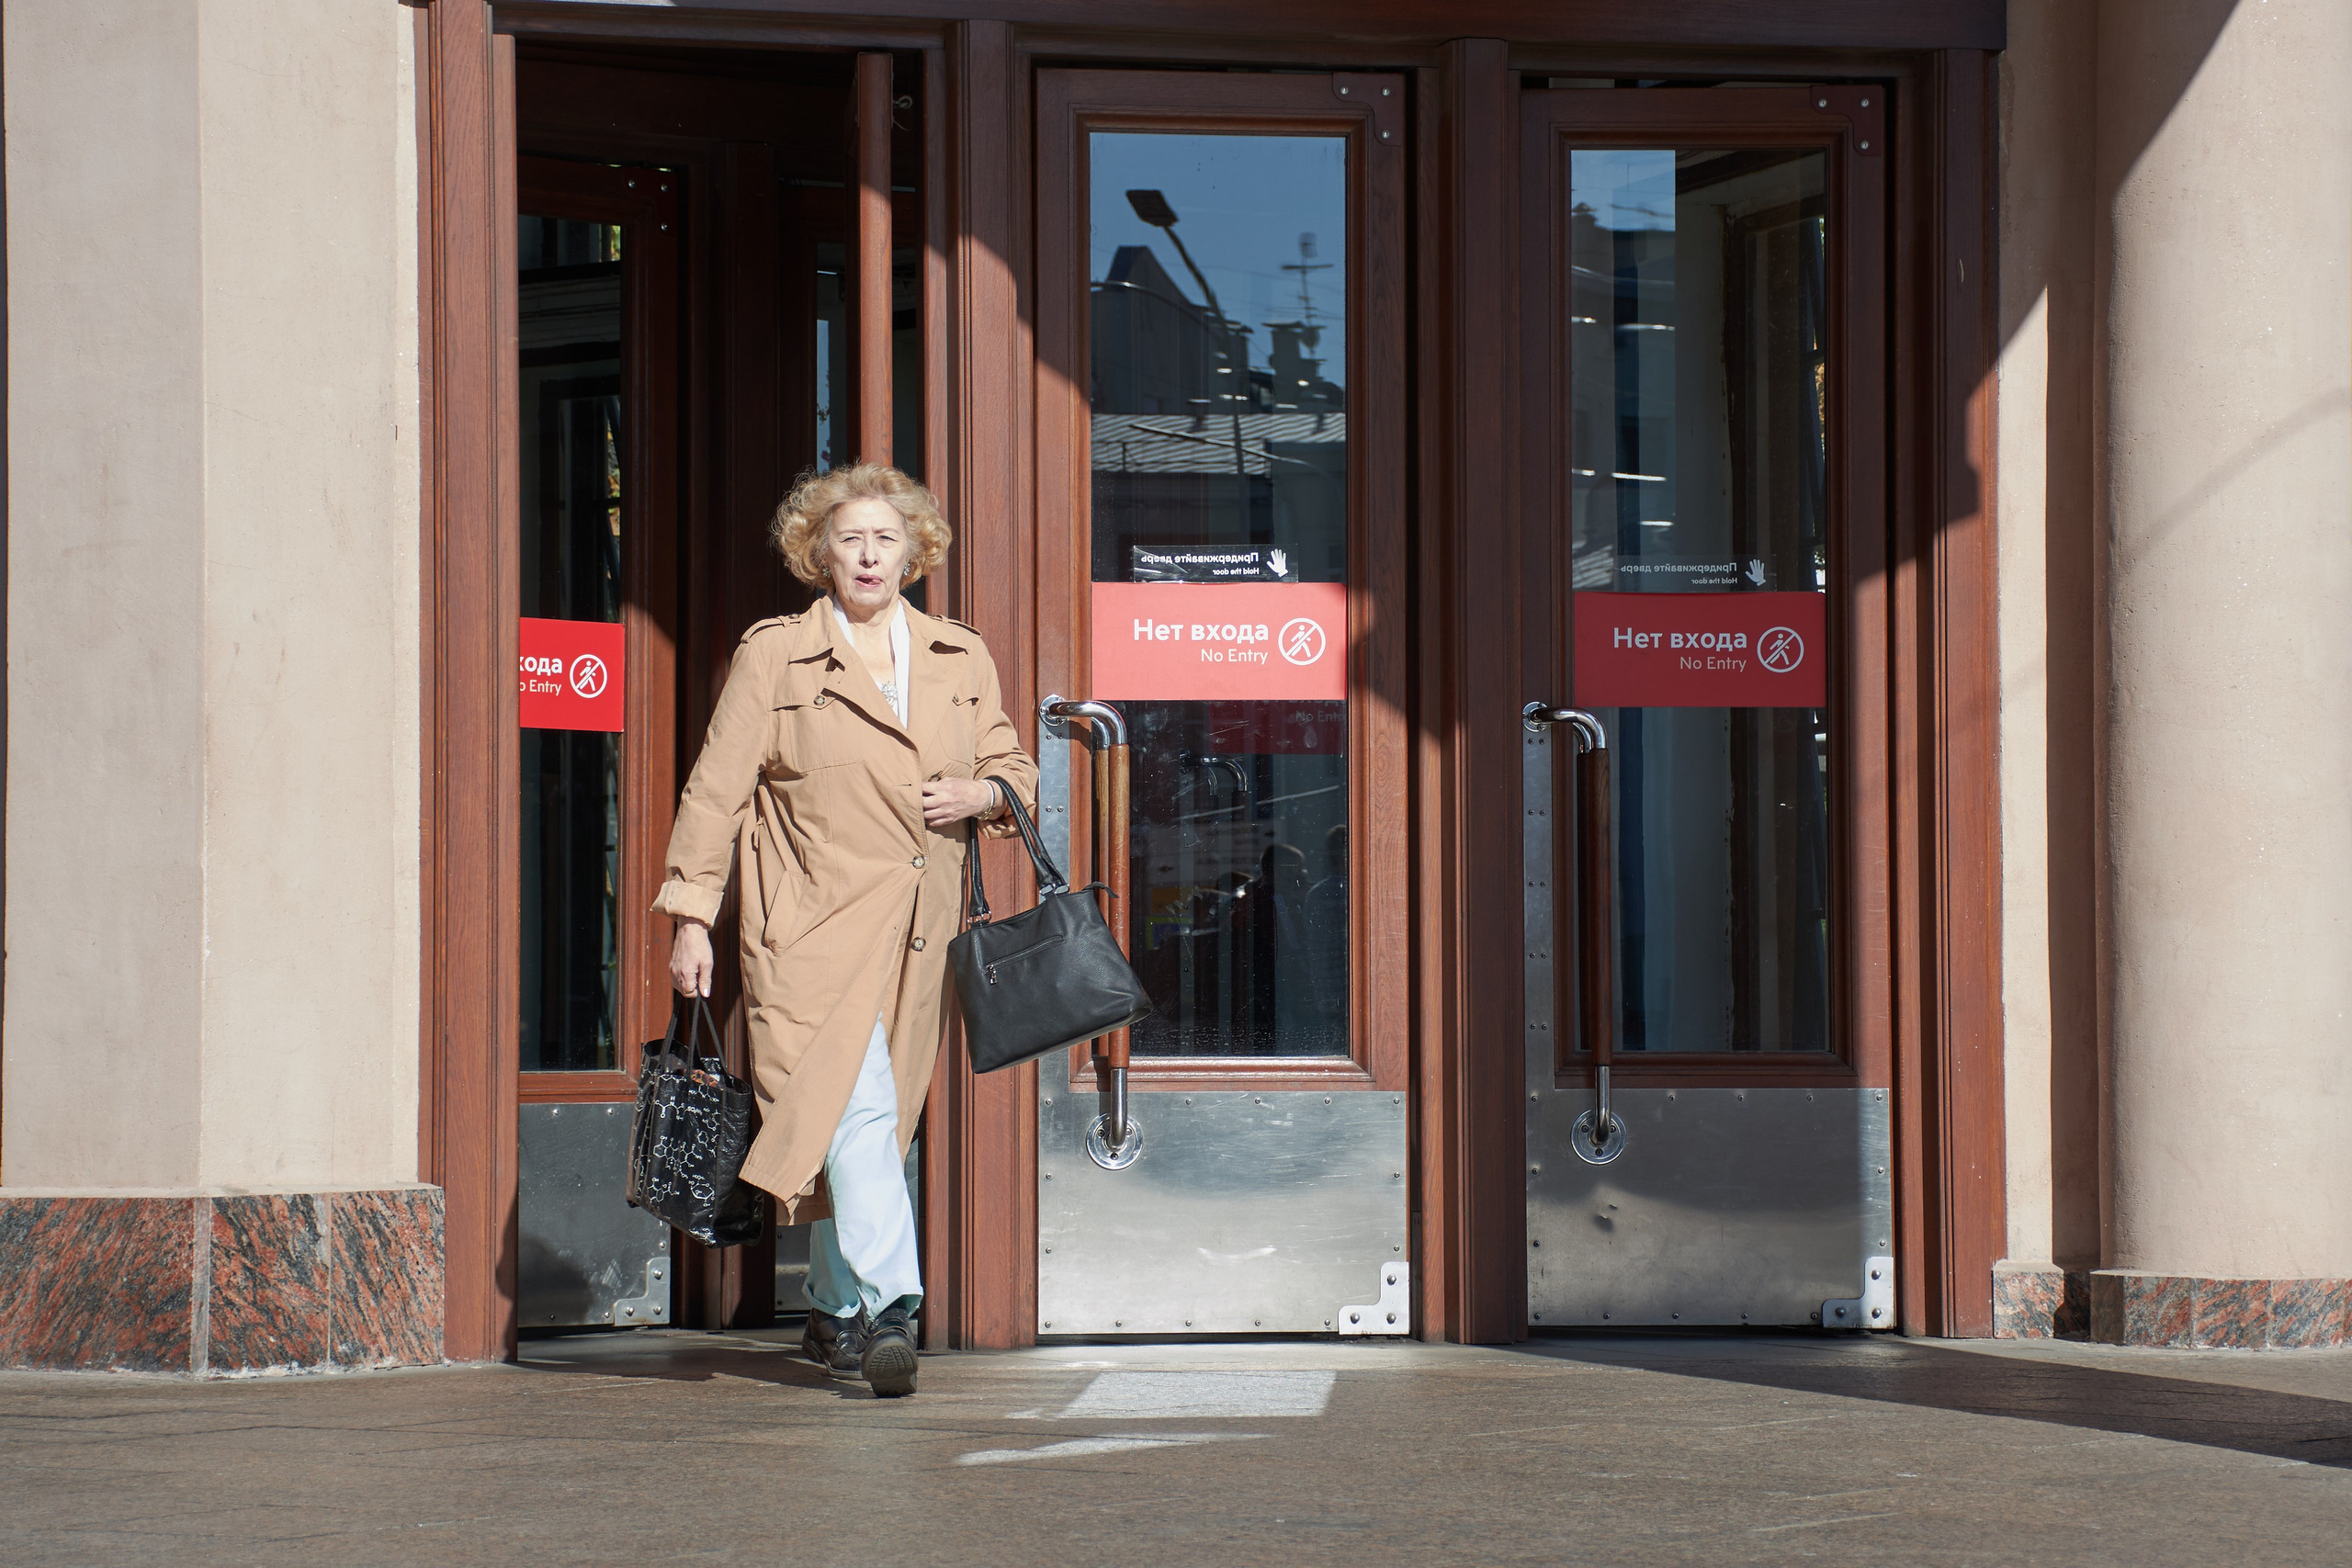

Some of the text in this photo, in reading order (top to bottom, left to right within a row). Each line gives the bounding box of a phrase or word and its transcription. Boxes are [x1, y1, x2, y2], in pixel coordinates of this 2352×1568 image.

[1134, 618, 1269, 644] Нет входа
[1613, 627, 1747, 652] Нет входа
[1201, 649, 1269, 665] No Entry
[1679, 657, 1747, 672] No Entry
[529, 680, 562, 696] Entry
